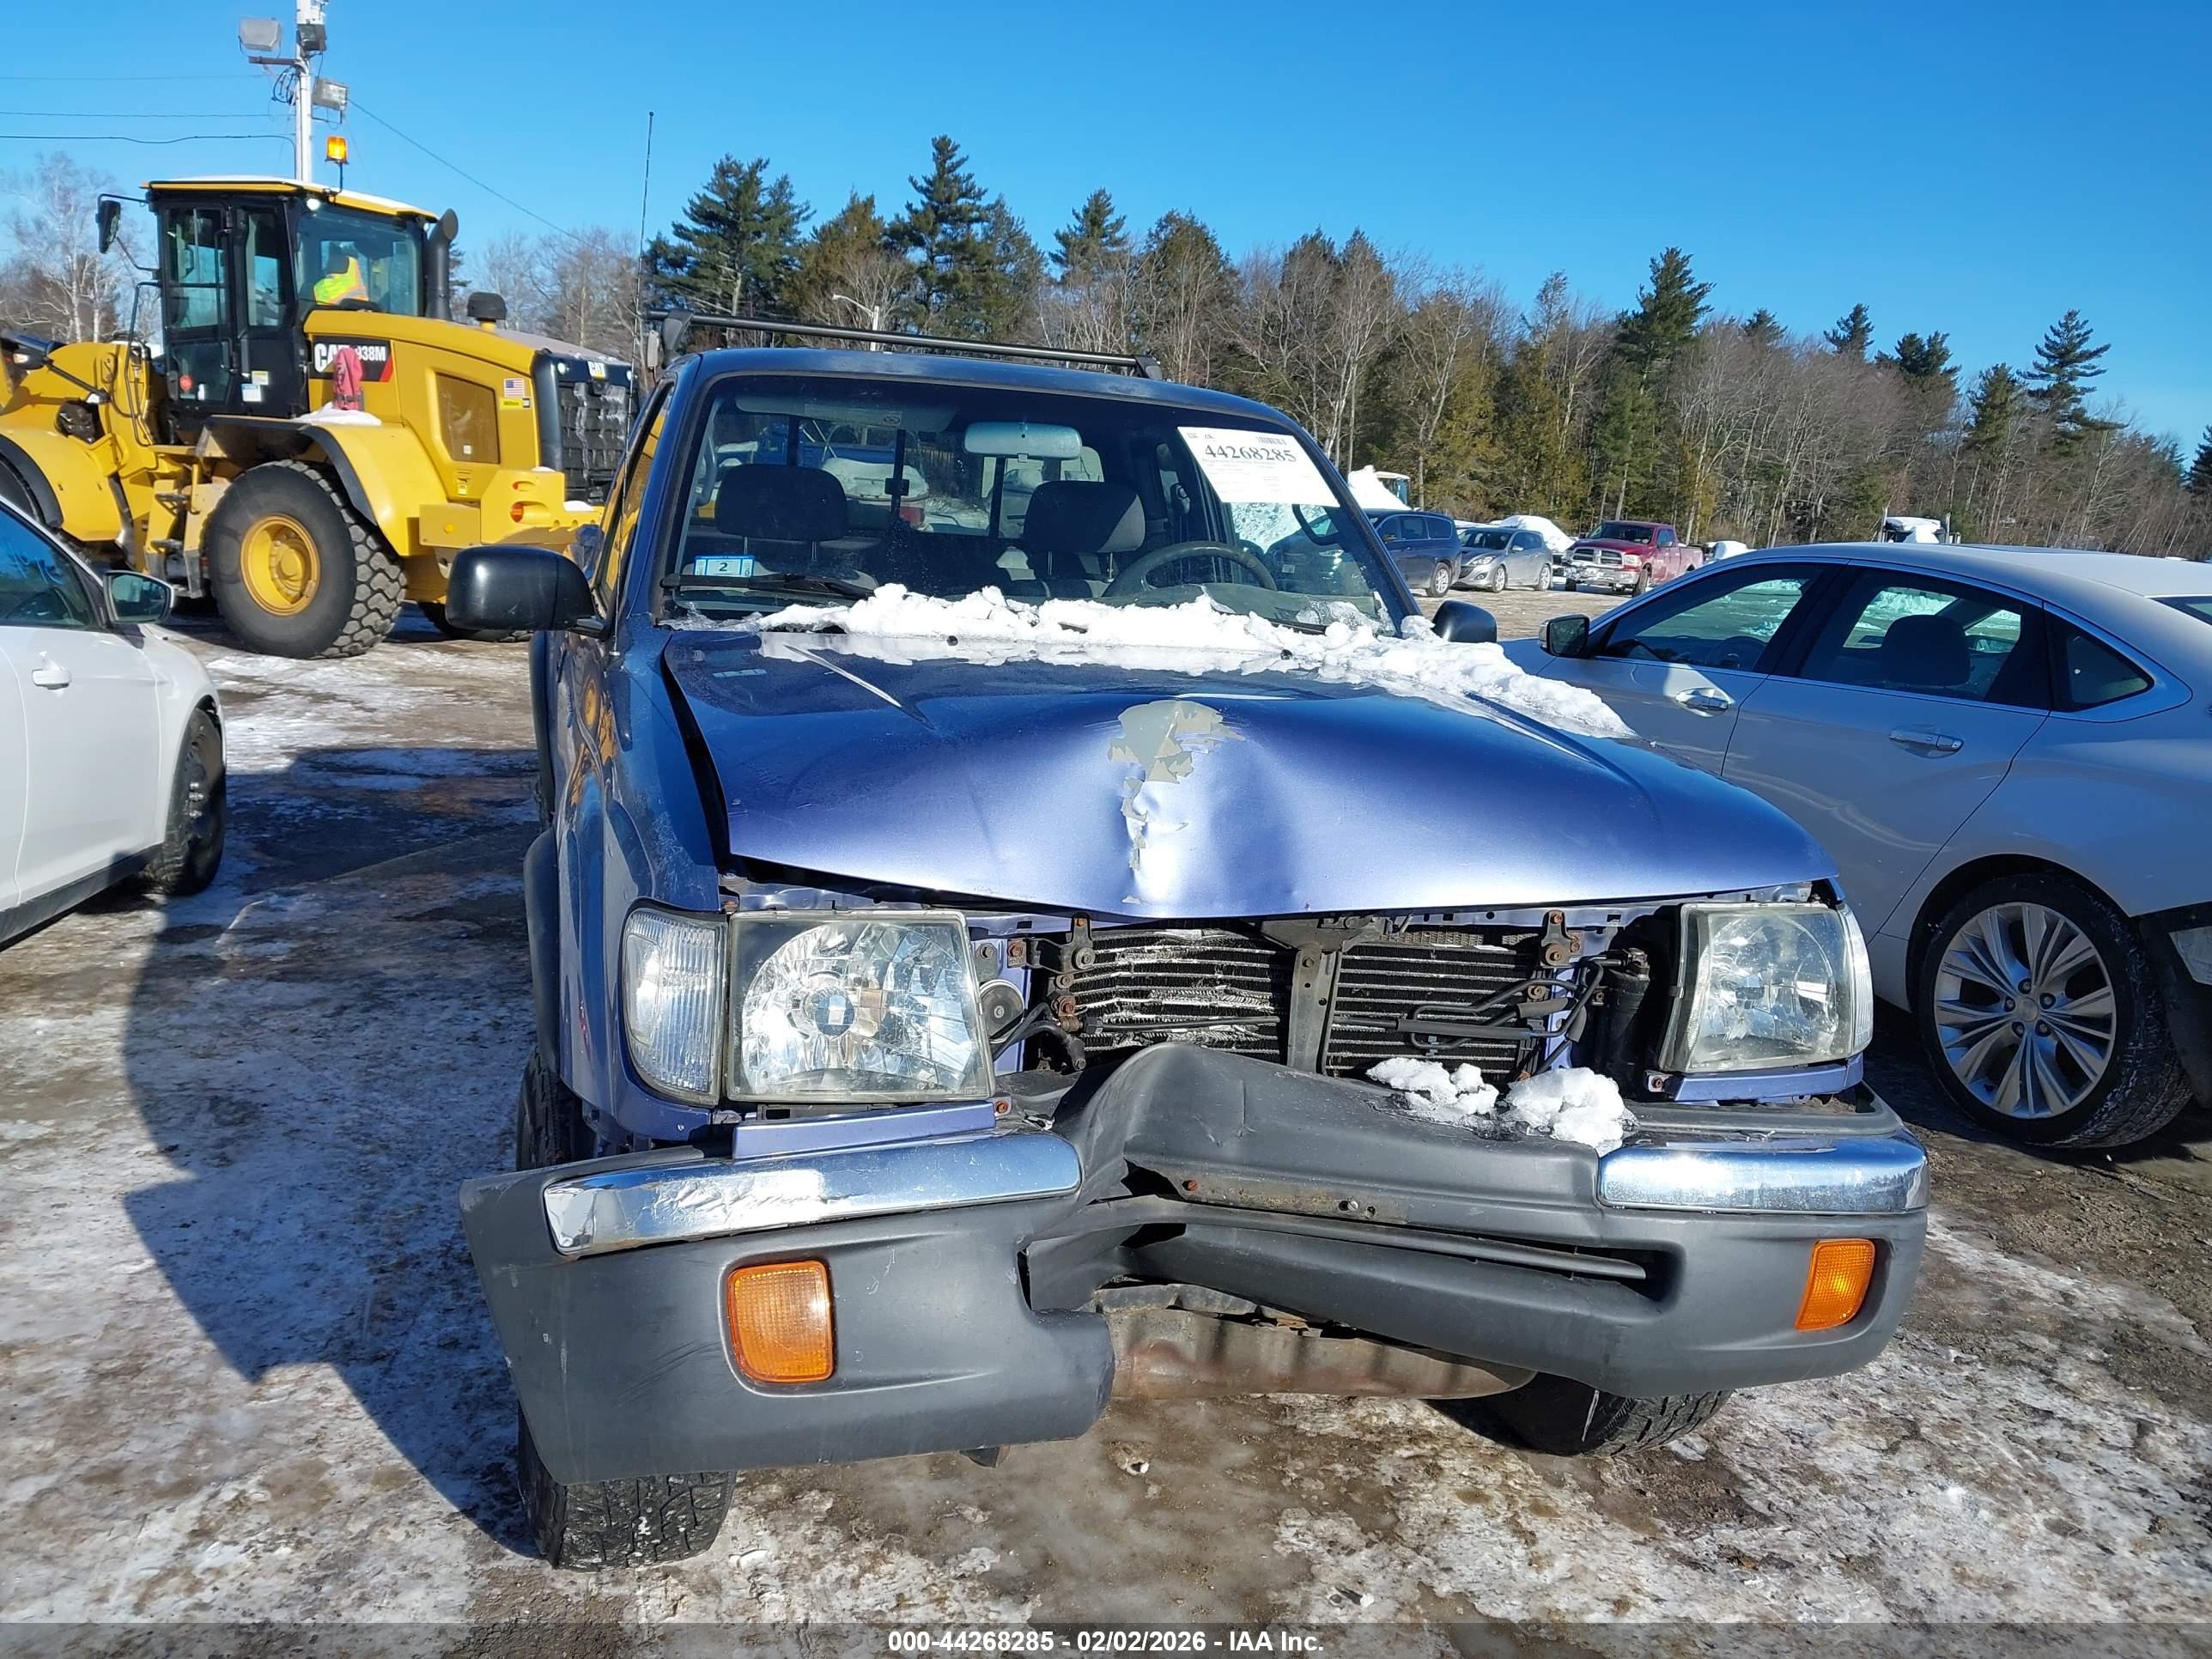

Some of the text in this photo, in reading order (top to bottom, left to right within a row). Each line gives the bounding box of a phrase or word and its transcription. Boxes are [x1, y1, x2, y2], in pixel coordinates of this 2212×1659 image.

[313, 343, 386, 373] CA 938M
[1205, 444, 1297, 463] 44268285
[719, 562, 728, 572] 2
